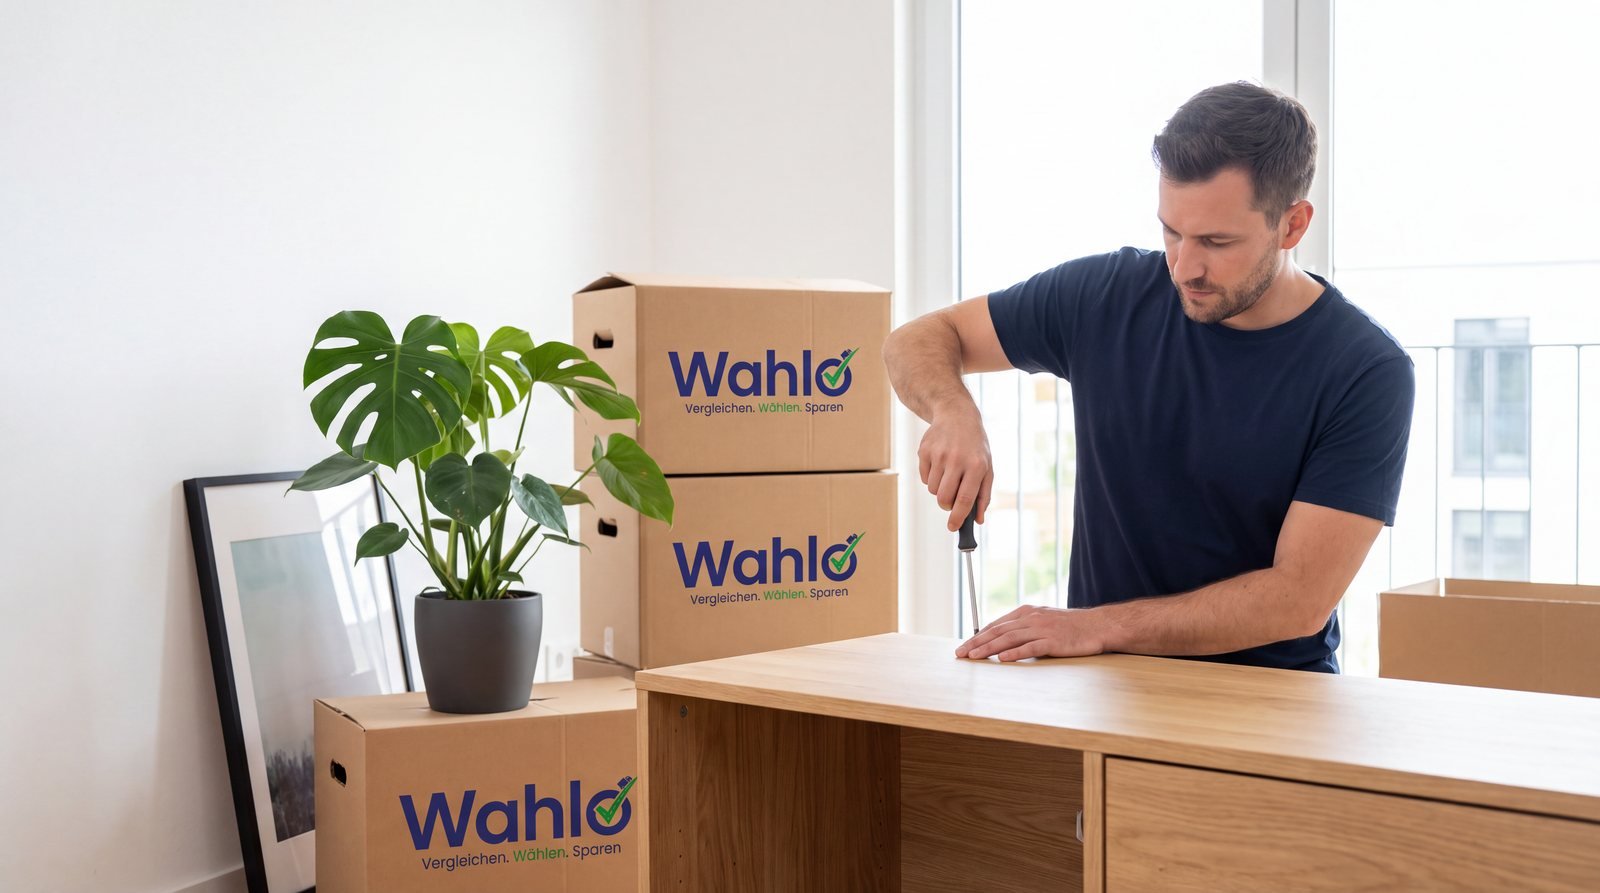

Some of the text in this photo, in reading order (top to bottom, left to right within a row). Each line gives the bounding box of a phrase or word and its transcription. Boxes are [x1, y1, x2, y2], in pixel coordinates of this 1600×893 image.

[668, 349, 854, 397] Wahlo
[685, 402, 844, 416] Vergleichen. Wählen. Sparen
[672, 535, 858, 589] Wahlo
[690, 587, 849, 607] Vergleichen. Wählen. Sparen
[399, 779, 632, 851] Wahlo
[422, 842, 622, 872] Vergleichen. Wählen. Sparen
